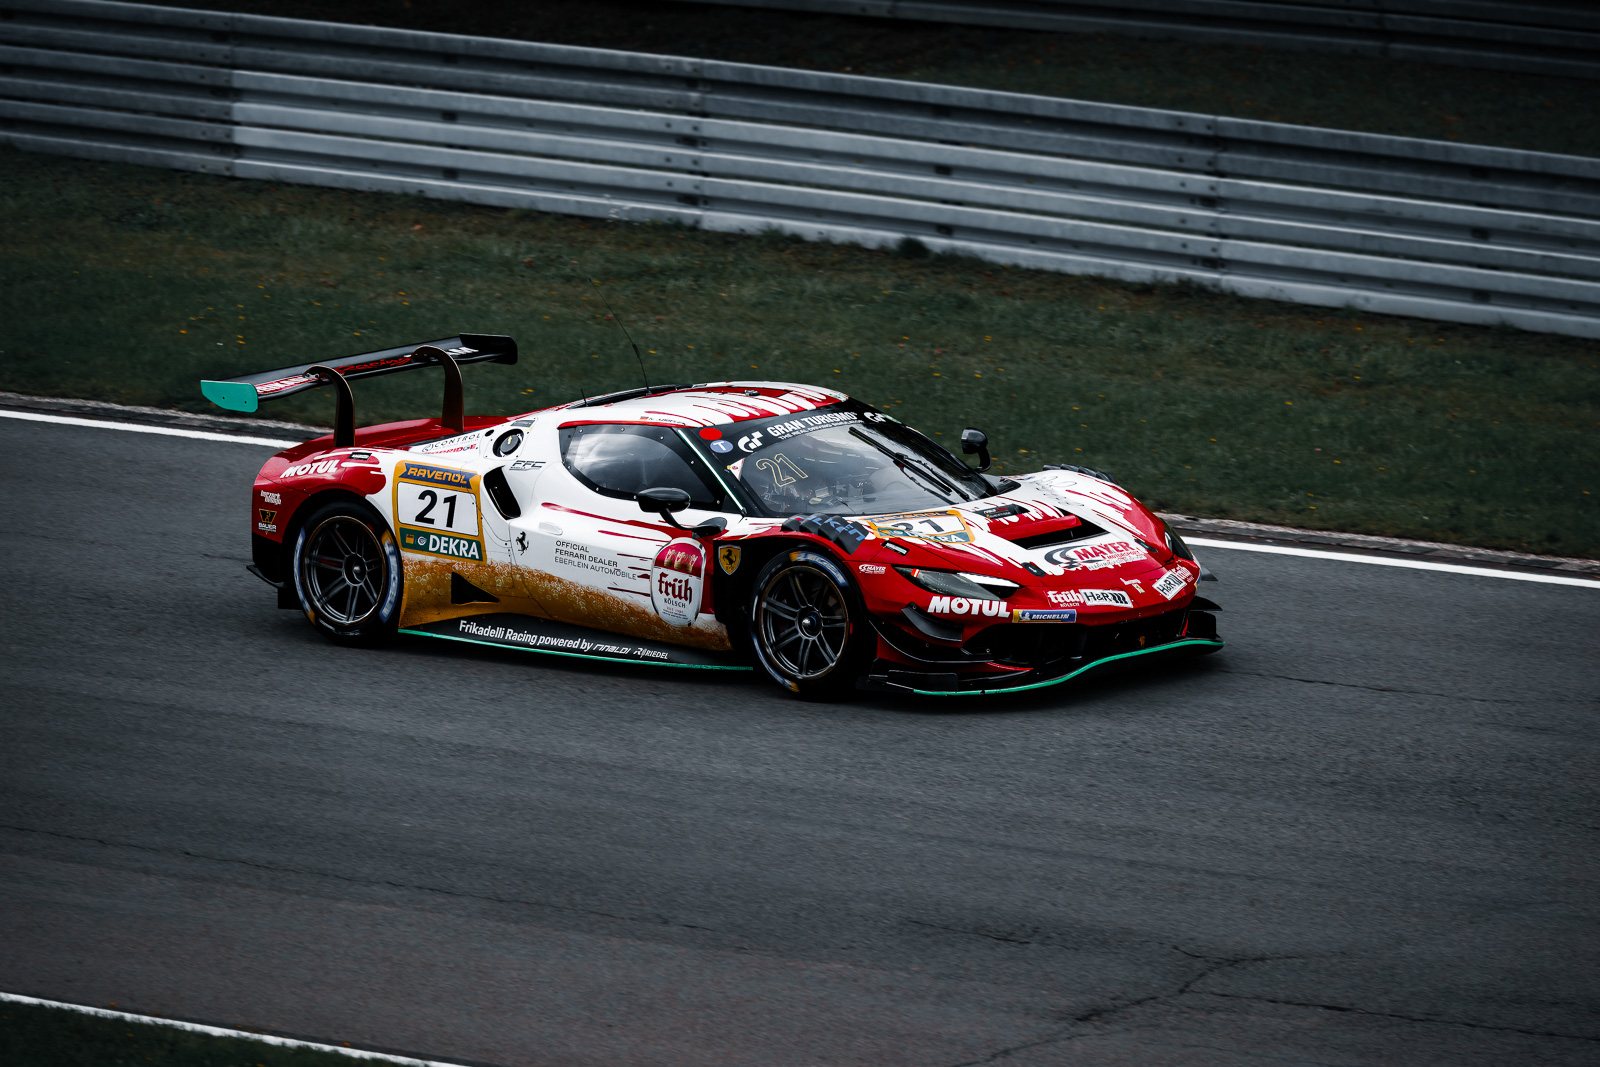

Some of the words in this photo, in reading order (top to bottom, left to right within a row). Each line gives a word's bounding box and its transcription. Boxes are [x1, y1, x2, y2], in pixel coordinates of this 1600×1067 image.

[766, 419, 805, 437] GRAN
[801, 411, 857, 427] TURISMO
[434, 433, 480, 448] CONTROL
[279, 459, 340, 478] MOTUL
[407, 467, 467, 484] RAVENOL
[756, 453, 808, 487] 21
[415, 489, 457, 529] 21
[428, 534, 480, 560] DEKRA
[555, 540, 590, 553] OFFICIAL
[1073, 541, 1135, 561] MAYER
[554, 556, 589, 570] EBERLEIN
[589, 564, 637, 580] AUTOMOBILE
[555, 548, 587, 561] FERRARI
[588, 555, 618, 568] DEALER
[1084, 591, 1111, 602] H&R
[1156, 579, 1177, 596] H&R
[664, 598, 686, 608] KÖLSCH
[927, 596, 1011, 618] MOTUL
[459, 620, 505, 639] Frikadelli
[505, 628, 538, 646] Racing
[537, 635, 581, 649] powered
[580, 639, 594, 652] by
[645, 649, 668, 660] RIEDEL
